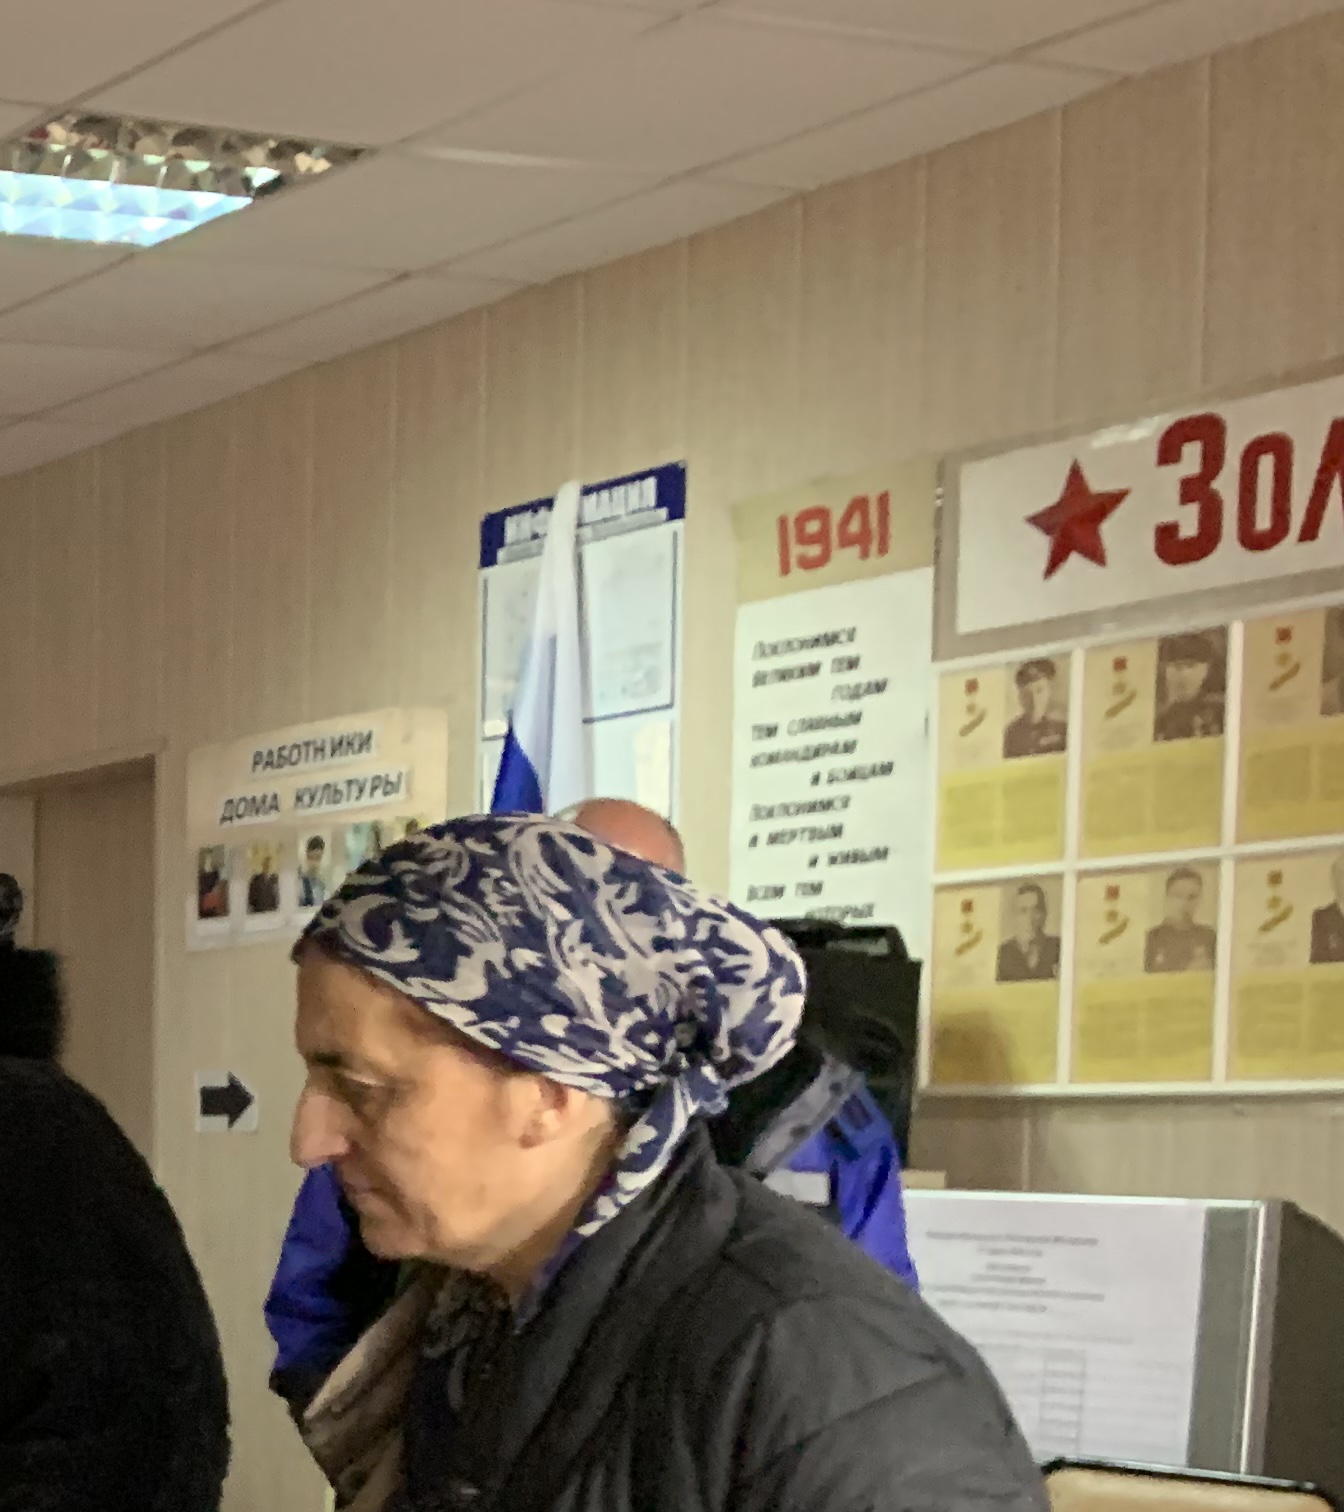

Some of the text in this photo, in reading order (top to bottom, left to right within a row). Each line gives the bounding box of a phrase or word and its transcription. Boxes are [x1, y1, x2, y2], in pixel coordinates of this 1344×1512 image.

[777, 490, 890, 577] 1941
[251, 729, 373, 773] РАБОТНИКИ
[218, 771, 404, 826] ДОМА КУЛЬТУРЫ
